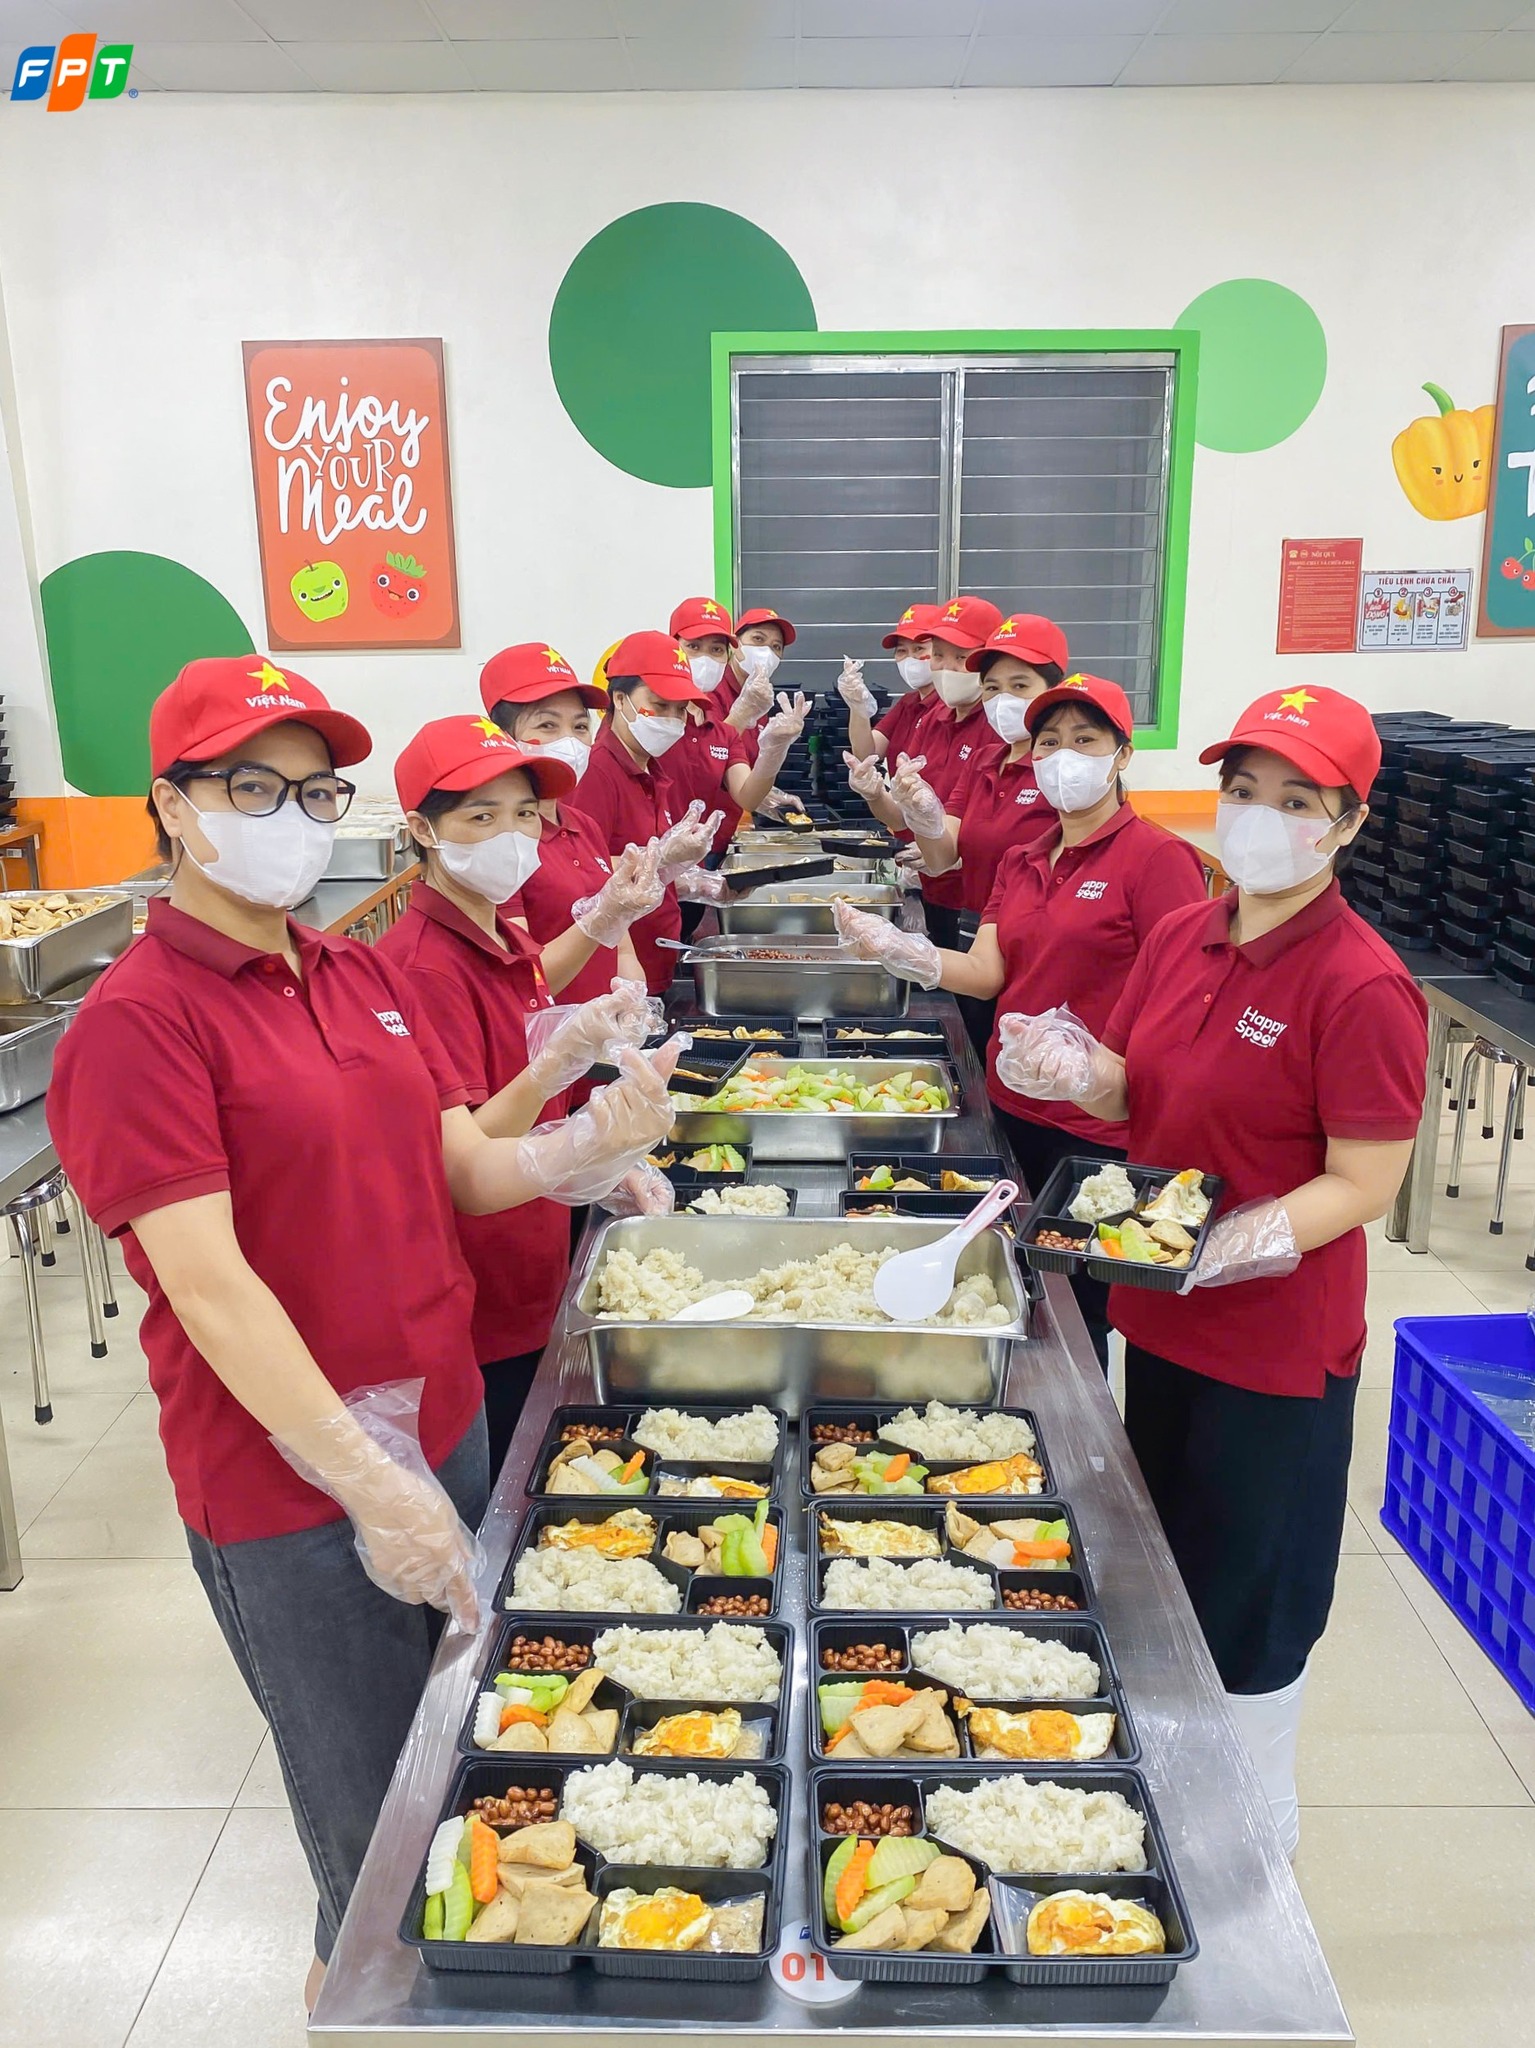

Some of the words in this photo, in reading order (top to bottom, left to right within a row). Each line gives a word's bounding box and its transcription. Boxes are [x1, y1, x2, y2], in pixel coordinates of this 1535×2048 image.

[265, 376, 430, 468] Enjoy
[300, 438, 401, 492] YOUR
[278, 456, 428, 545] Meal
[244, 694, 279, 709] Việt
[278, 694, 308, 710] Nam
[1284, 713, 1310, 728] Nam
[1235, 1019, 1277, 1048] Spoon
[1242, 1005, 1288, 1037] Happy
[782, 1953, 825, 1981] 01
